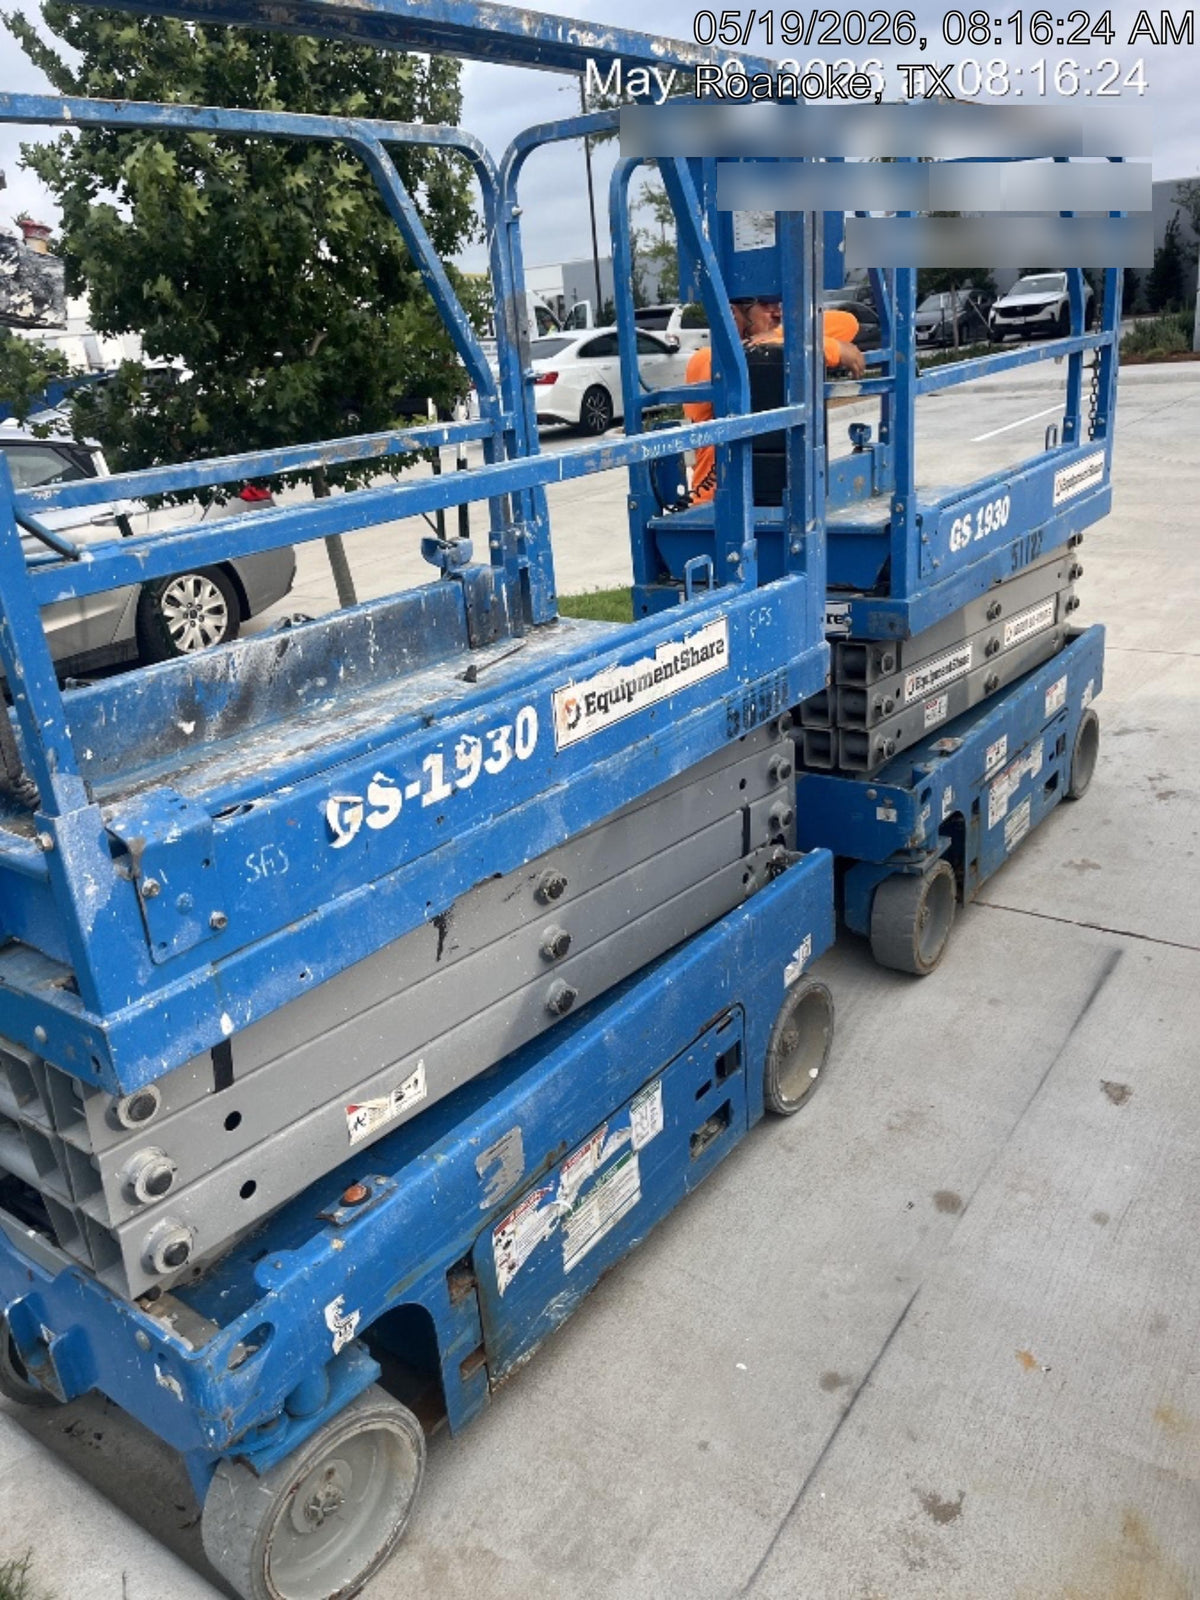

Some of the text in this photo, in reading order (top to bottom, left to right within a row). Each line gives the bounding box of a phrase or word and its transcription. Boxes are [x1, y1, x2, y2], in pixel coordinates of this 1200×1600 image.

[949, 495, 1011, 552] GS 1930
[584, 637, 724, 718] EquipmentShare
[325, 705, 538, 849] GS-1930
